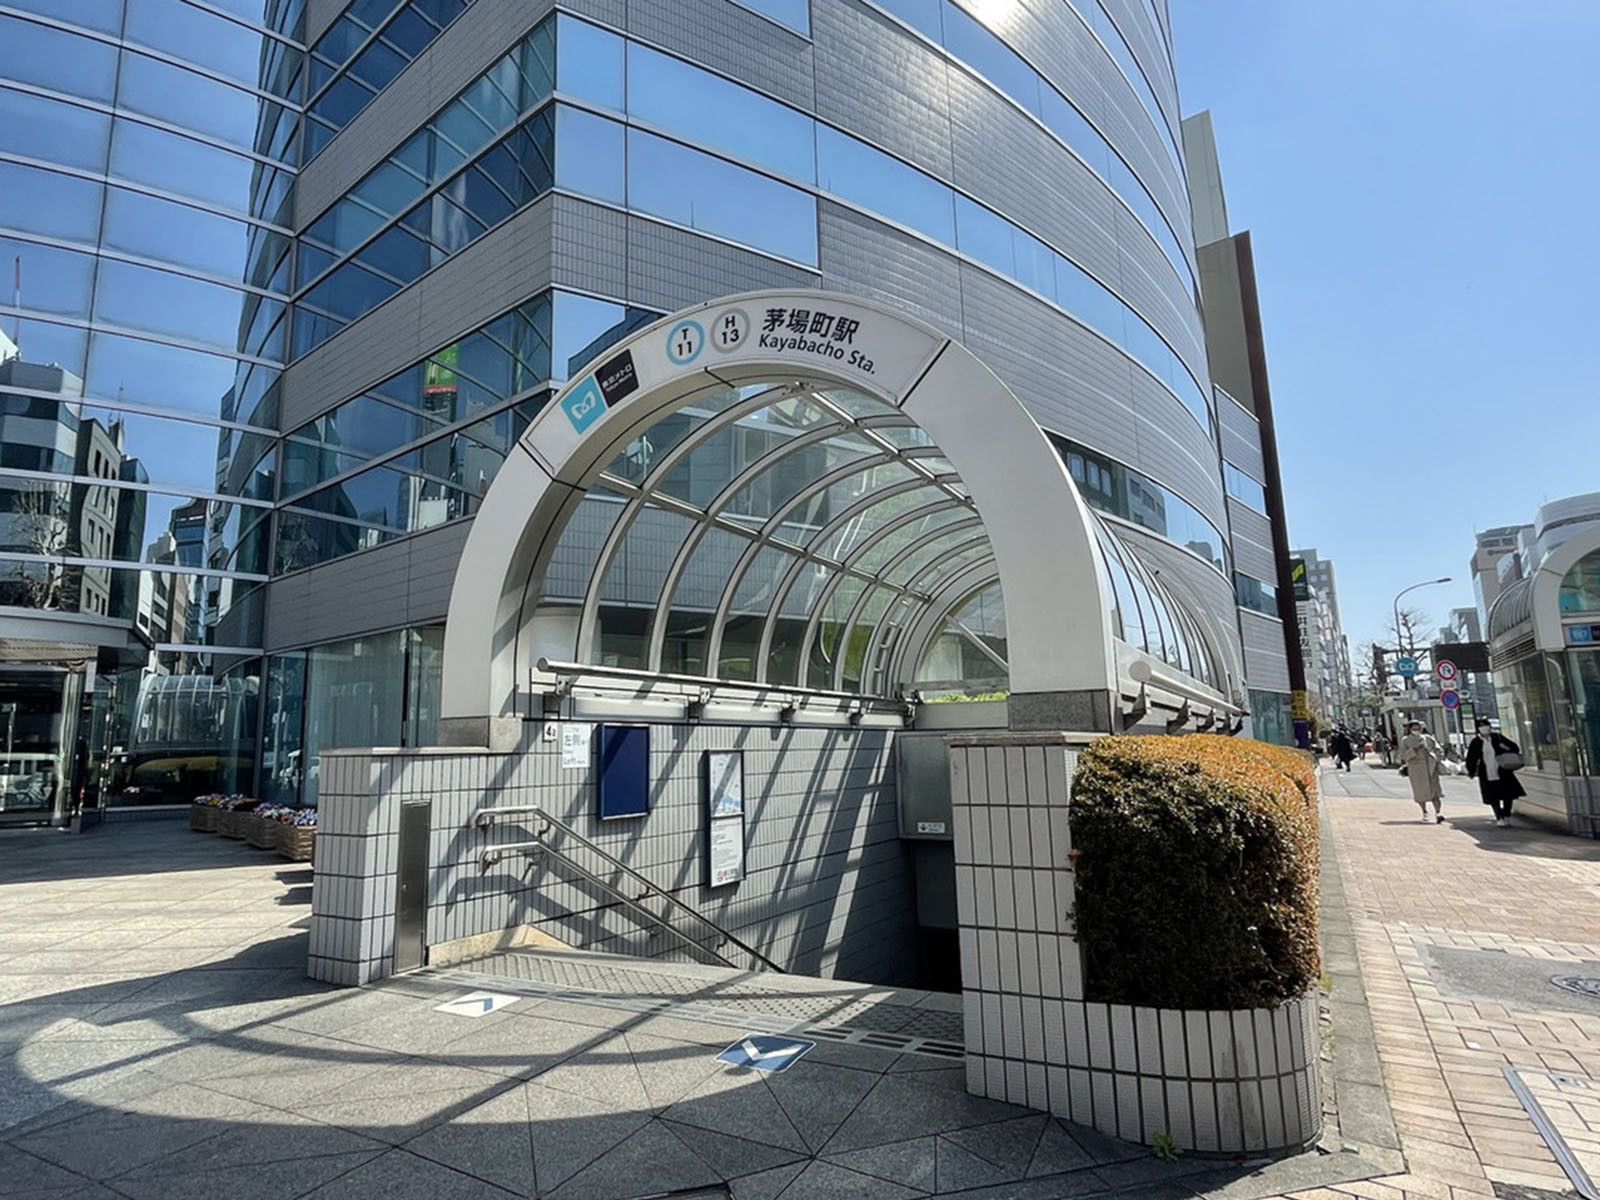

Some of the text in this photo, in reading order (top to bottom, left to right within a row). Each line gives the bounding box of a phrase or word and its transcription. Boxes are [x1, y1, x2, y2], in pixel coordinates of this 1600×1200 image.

[725, 315, 736, 329] H
[762, 308, 860, 345] 茅場町駅
[681, 328, 689, 341] T
[722, 328, 740, 345] 13
[677, 341, 692, 356] 11
[758, 333, 875, 375] Kayabacho Sta.
